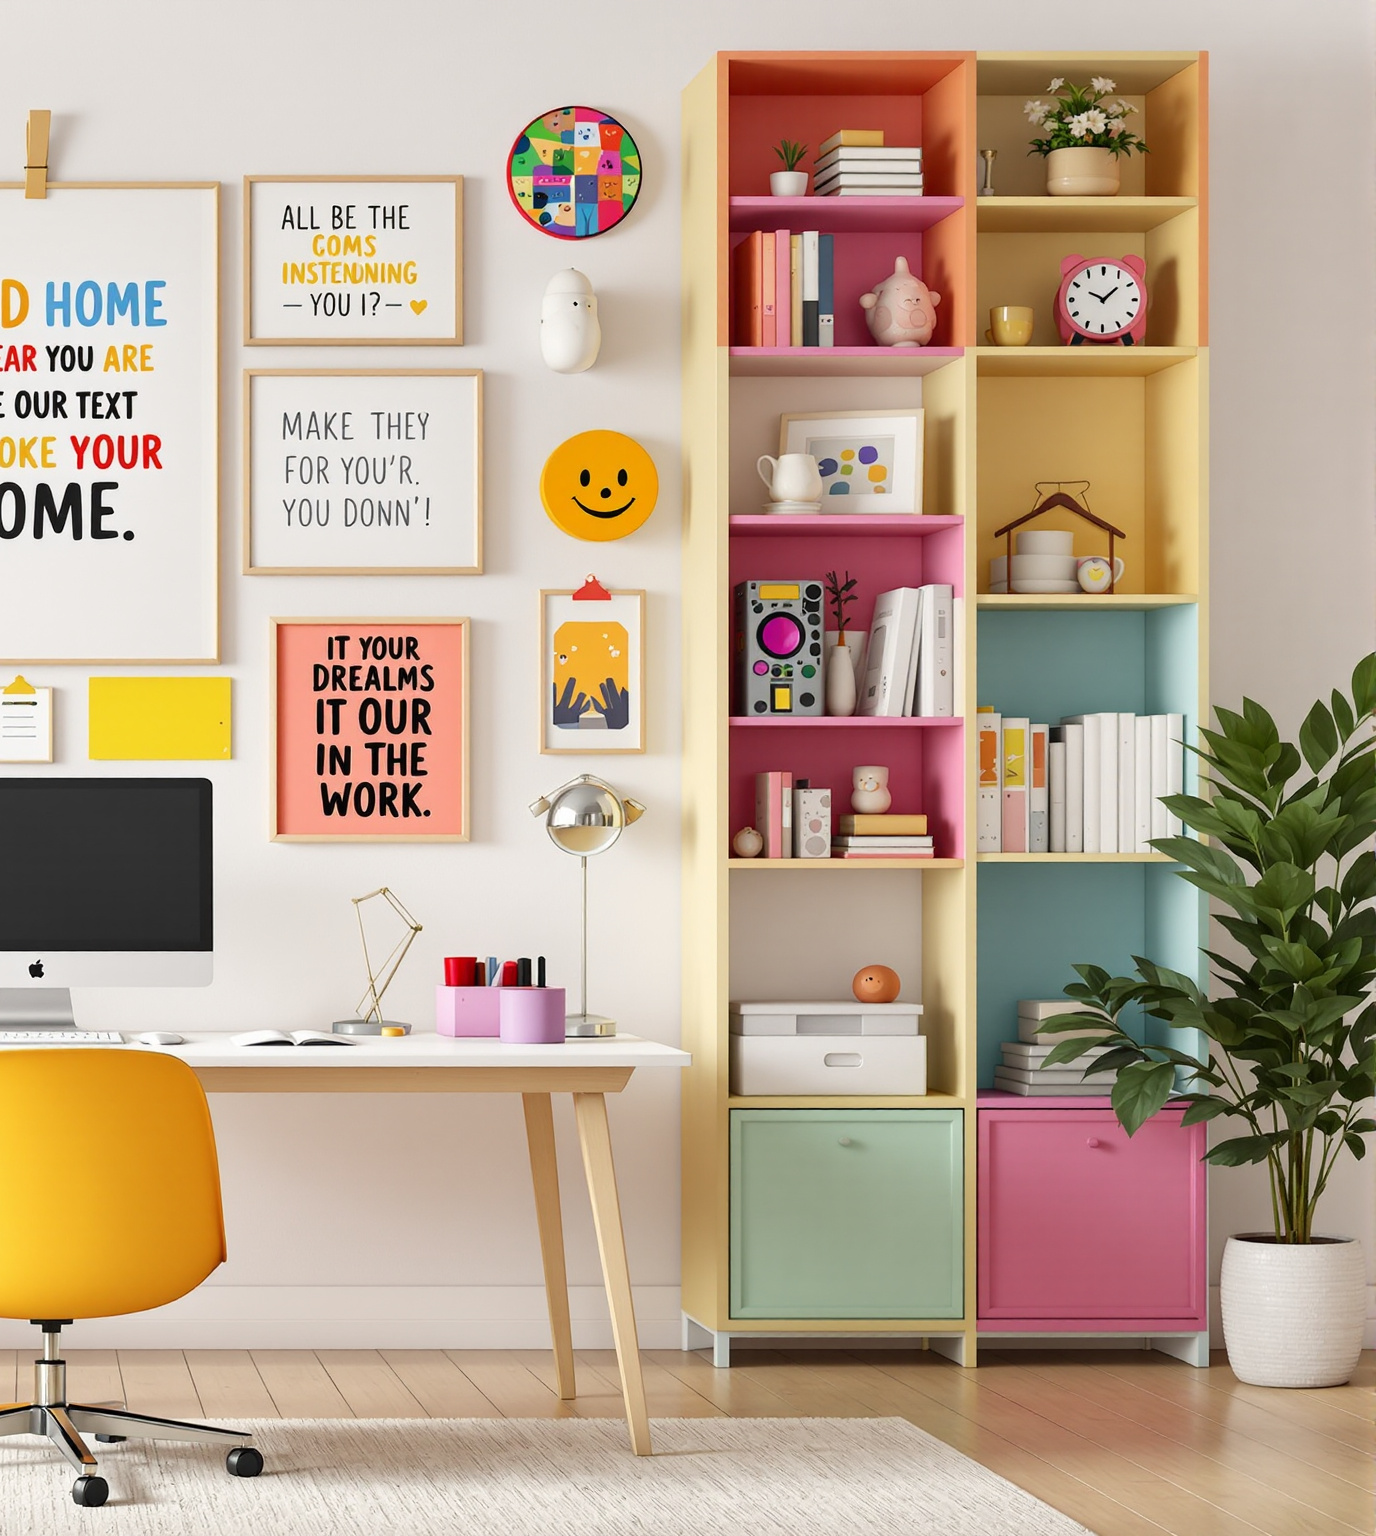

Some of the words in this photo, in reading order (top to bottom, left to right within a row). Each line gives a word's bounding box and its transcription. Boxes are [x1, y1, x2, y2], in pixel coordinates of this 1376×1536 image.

[281, 204, 321, 230] ALL
[331, 204, 357, 231] BE
[367, 204, 411, 230] THE
[45, 280, 168, 328] HOME
[309, 291, 351, 317] YOU
[44, 344, 94, 373] YOU
[102, 343, 155, 373] ARE
[14, 389, 69, 420] OUR
[75, 390, 139, 420] TEXT
[282, 410, 355, 441] MAKE
[370, 411, 430, 441] THEY
[69, 433, 163, 471] YOUR
[285, 455, 330, 485] FOR
[340, 454, 420, 486] YOU'R.
[282, 498, 330, 528] YOU
[327, 635, 351, 661] IT
[358, 635, 421, 661] YOUR
[312, 663, 435, 693] DREALMS
[316, 698, 348, 736] IT
[358, 697, 433, 736] OUR
[316, 742, 352, 777] IN
[364, 741, 429, 777] THE
[320, 781, 432, 819] WORK.
